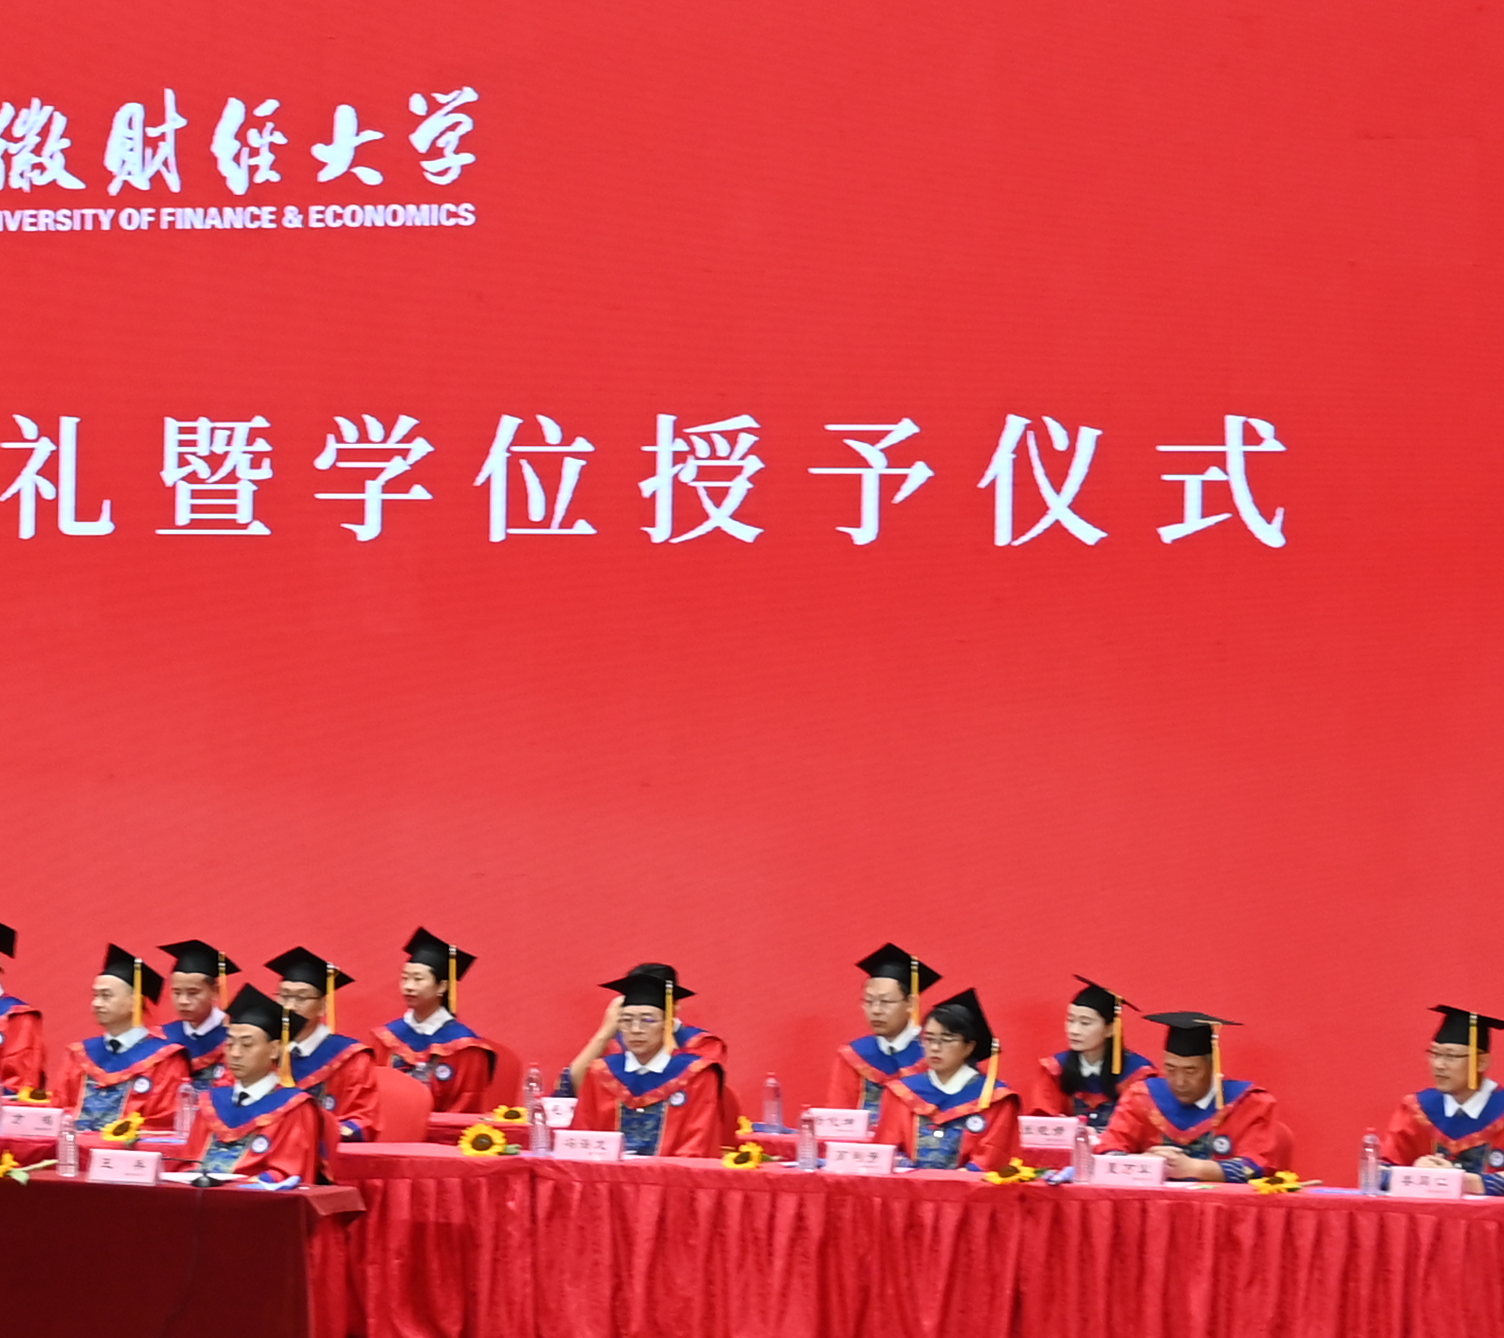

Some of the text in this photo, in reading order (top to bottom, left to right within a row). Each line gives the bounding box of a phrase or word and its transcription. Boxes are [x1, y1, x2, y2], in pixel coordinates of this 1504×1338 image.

[118, 207, 156, 231] OF
[160, 206, 278, 230] FINANCE
[282, 205, 304, 229] &
[308, 202, 476, 228] ECONOMICS
